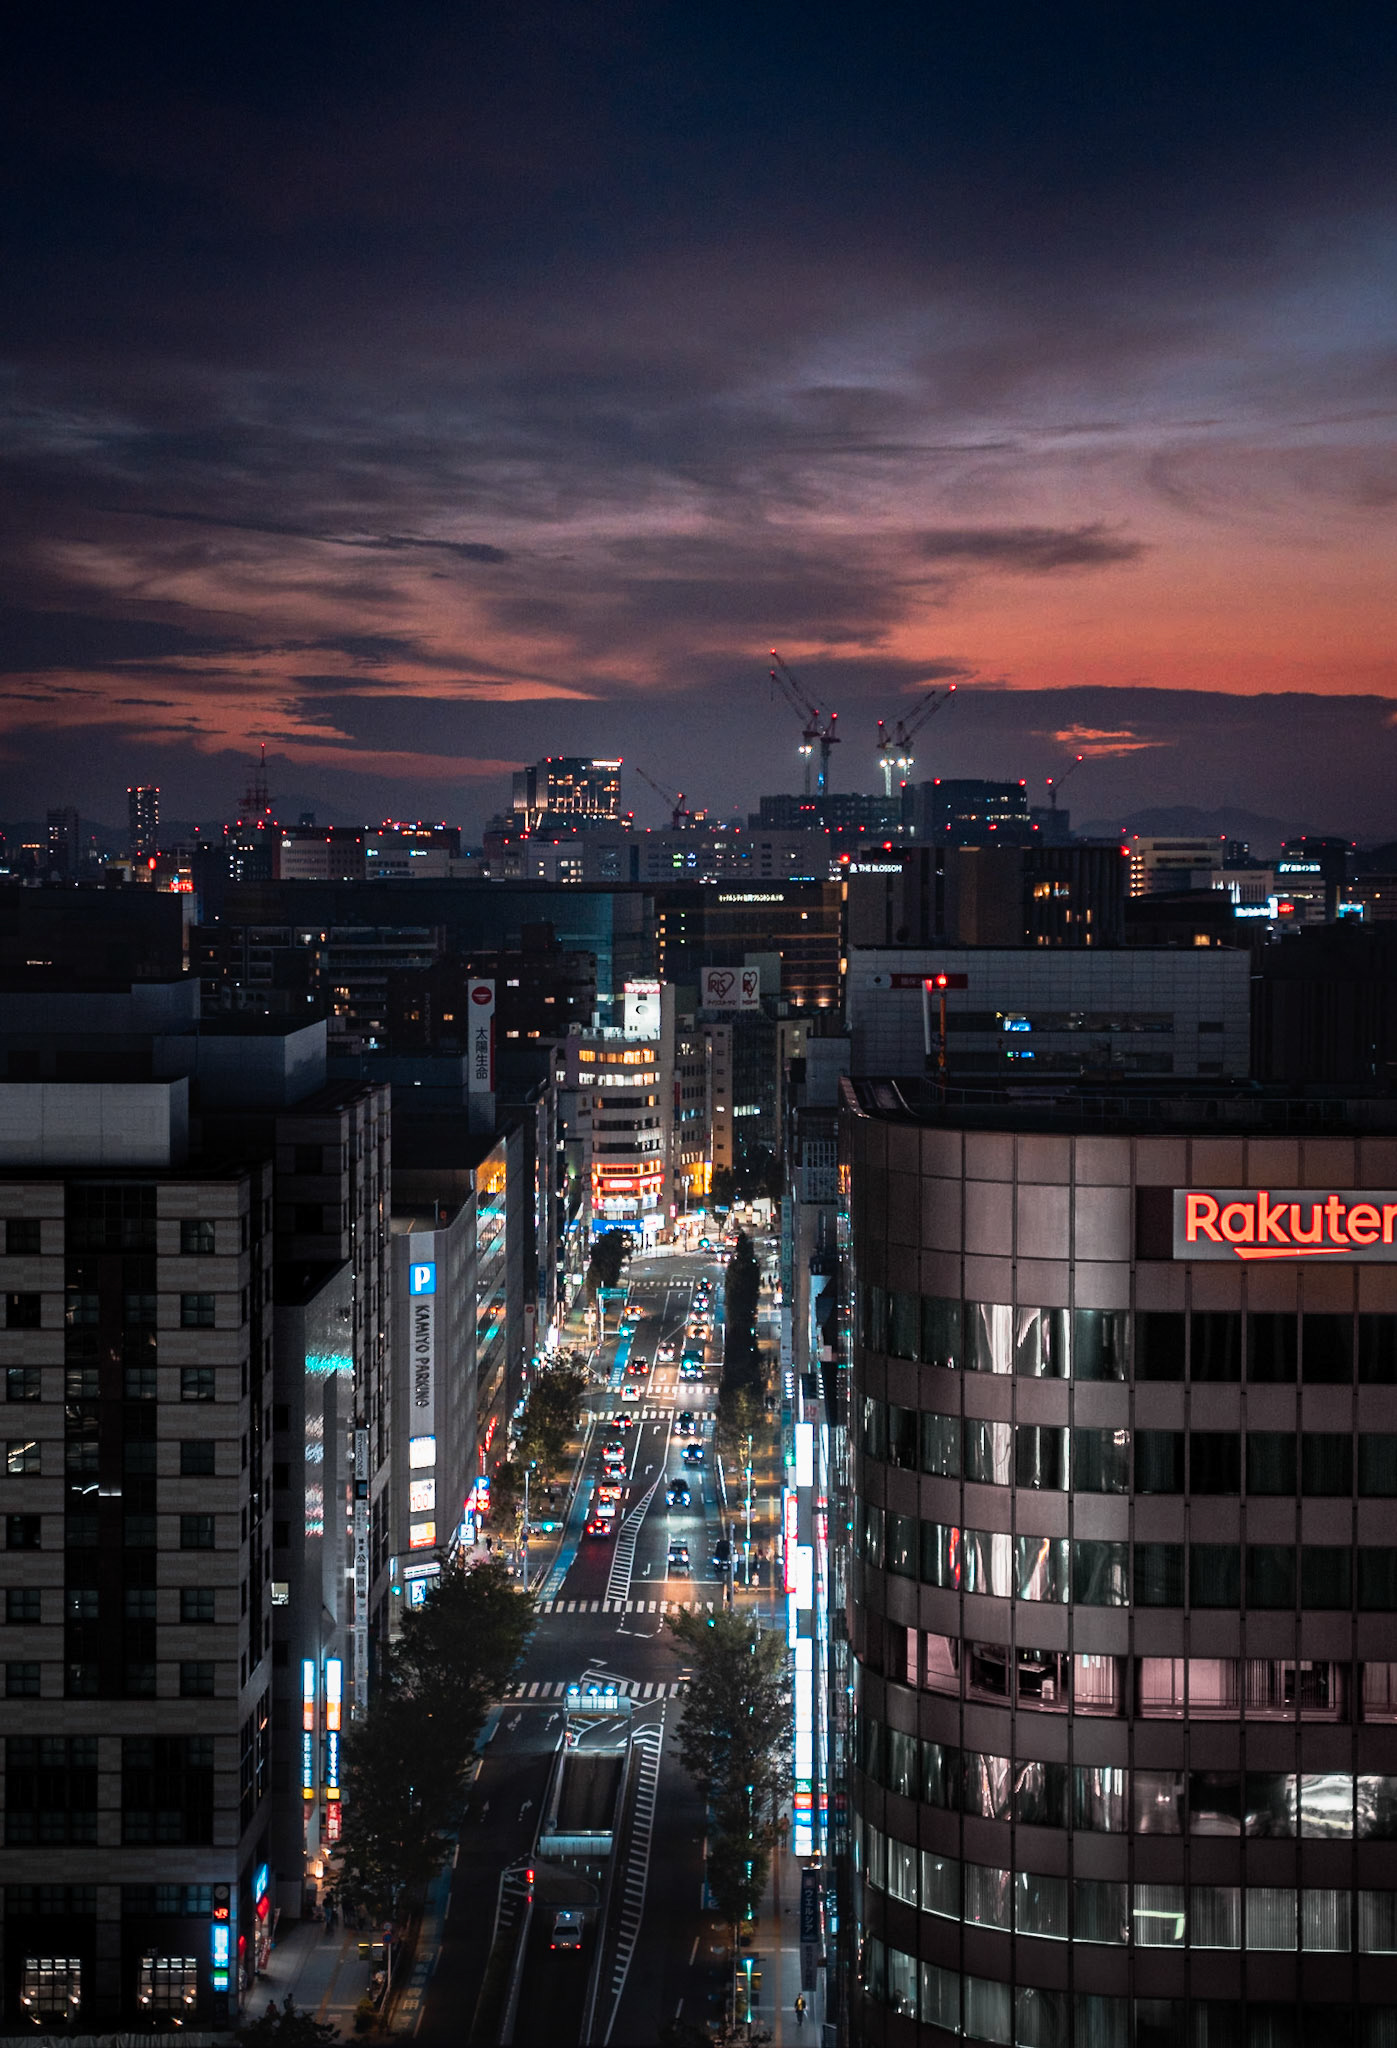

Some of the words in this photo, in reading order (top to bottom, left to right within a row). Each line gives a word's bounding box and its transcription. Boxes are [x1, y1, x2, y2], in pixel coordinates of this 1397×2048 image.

[858, 864, 871, 873] THE
[872, 864, 903, 873] BLOSSOM
[475, 1027, 488, 1080] 太陽生命
[414, 1266, 431, 1292] P
[415, 1304, 430, 1354] KAMIYO
[415, 1357, 430, 1408] PARKING
